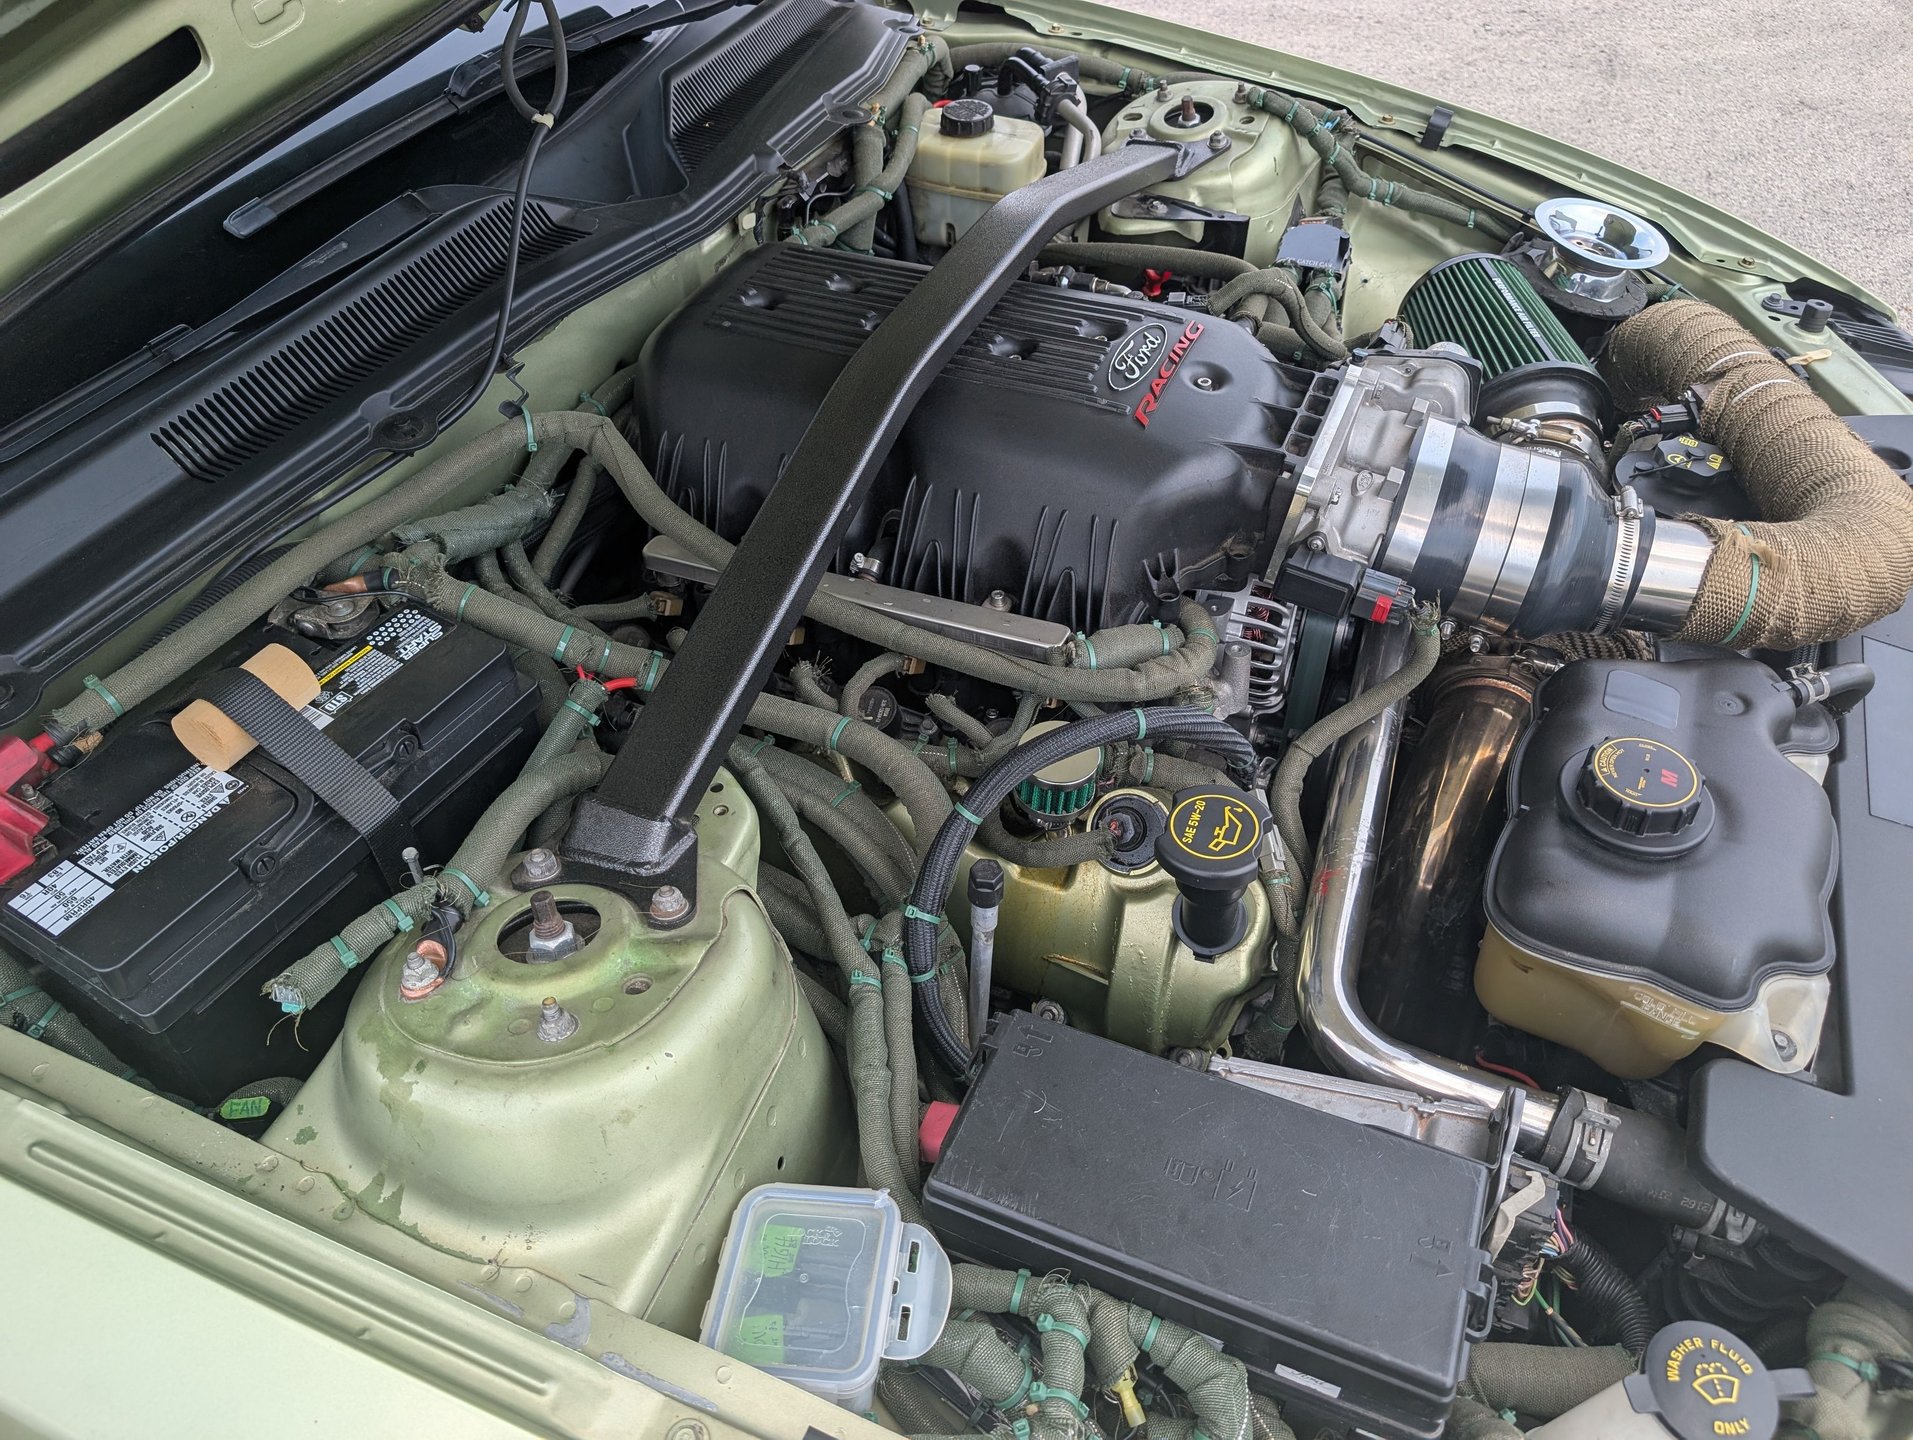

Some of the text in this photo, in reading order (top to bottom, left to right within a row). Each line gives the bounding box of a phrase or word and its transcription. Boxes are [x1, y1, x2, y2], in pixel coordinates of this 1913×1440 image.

[1491, 276, 1540, 338] PERFORMANCE AIR FILTER
[1114, 331, 1162, 379] Ford
[1133, 319, 1204, 426] RACING
[394, 621, 444, 658] START
[401, 629, 444, 661] SUPER
[323, 693, 347, 711] STD
[186, 766, 202, 777] KEEP
[176, 776, 188, 784] OUT
[141, 795, 155, 804] NOT
[158, 790, 170, 798] THE
[140, 797, 160, 811] REACH
[112, 817, 124, 825] NOT
[123, 810, 133, 818] DO
[1182, 800, 1206, 844] SAE 5W-20
[71, 836, 99, 855] BATTERY.
[90, 836, 107, 848] READ
[130, 805, 221, 873] DANGER/POISON
[80, 847, 92, 856] ALL
[94, 843, 108, 854] HELP
[96, 856, 108, 864] GET
[100, 849, 134, 873] WITH WATER.
[105, 851, 139, 876] IMMEDIATELY
[113, 854, 143, 876] FLUSH EYES
[46, 866, 63, 878] LB3
[18, 890, 30, 899] T6
[41, 883, 58, 895] 40R
[53, 891, 66, 900] 50
[61, 895, 78, 908] 650
[228, 1099, 263, 1116] FAN
[1666, 1336, 1753, 1382] WASHER FLUID
[1713, 1416, 1750, 1436] ONLY
